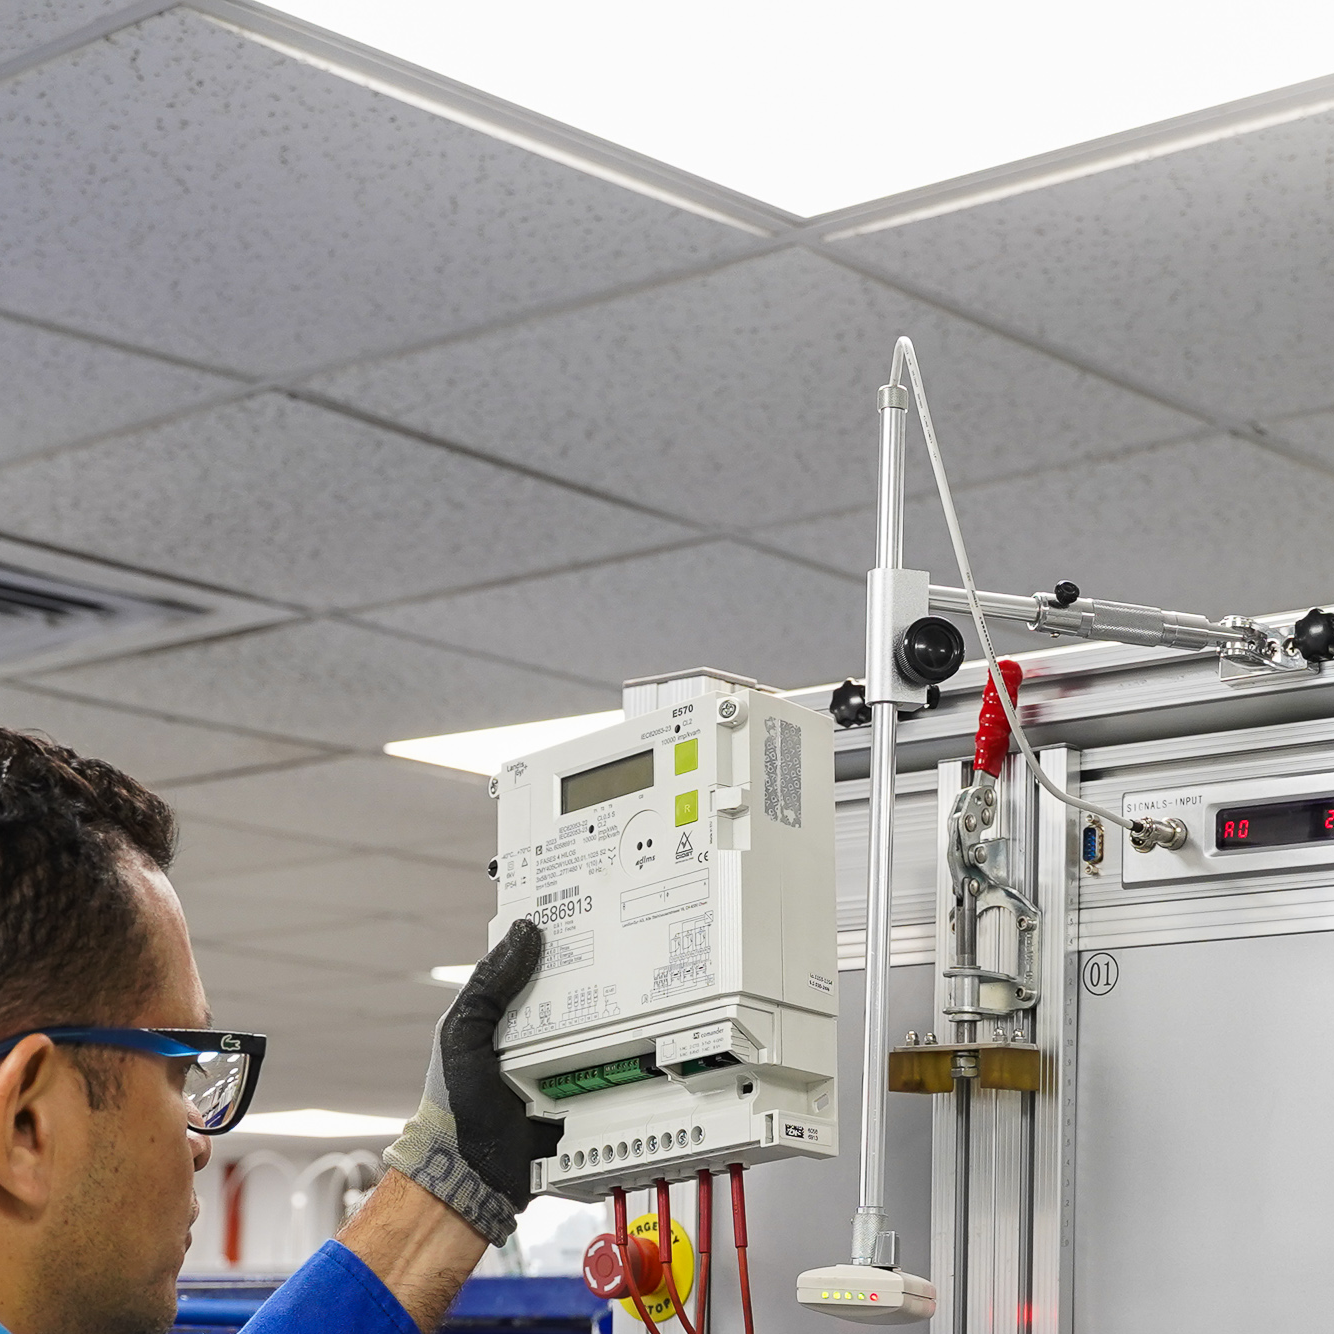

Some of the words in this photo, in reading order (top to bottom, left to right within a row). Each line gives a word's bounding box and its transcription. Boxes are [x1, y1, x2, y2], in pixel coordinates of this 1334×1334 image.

[672, 704, 694, 718] E570
[684, 804, 691, 813] R
[1126, 795, 1203, 813] SIGNALS-INPUT
[698, 850, 709, 863] CE
[1089, 961, 1113, 988] 01
